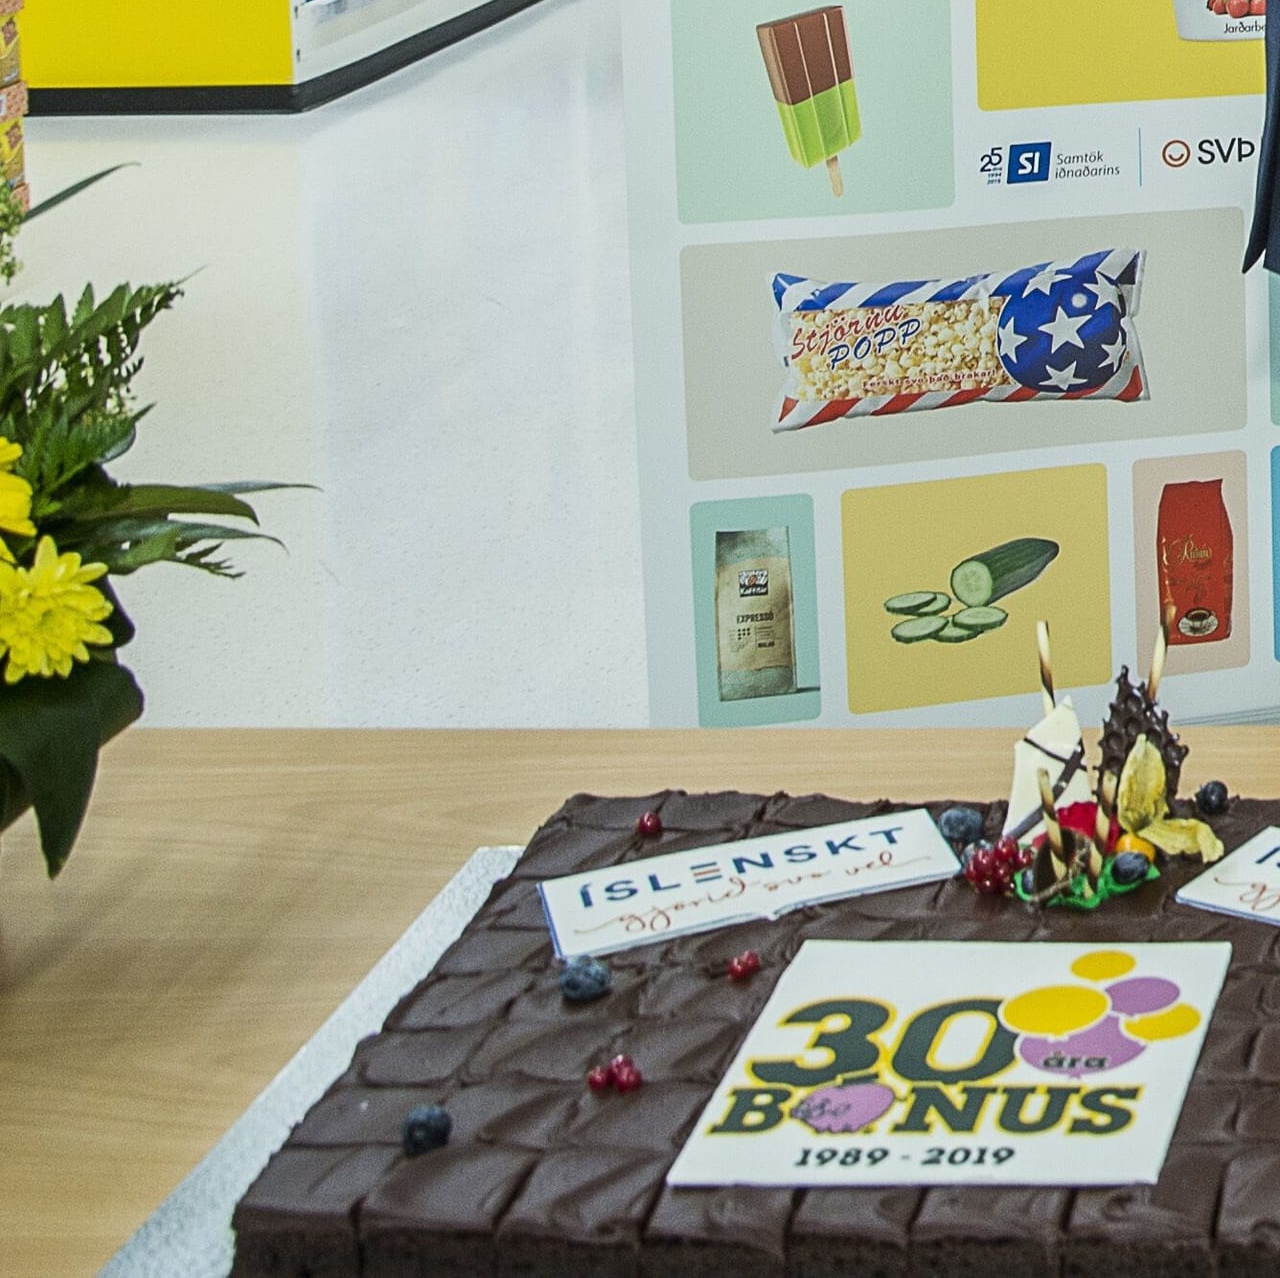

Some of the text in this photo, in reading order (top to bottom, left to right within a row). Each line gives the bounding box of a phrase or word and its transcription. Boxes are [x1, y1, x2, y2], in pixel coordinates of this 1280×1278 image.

[980, 147, 1104, 175] 25 SI Samtök
[1055, 137, 1256, 180] iðnaðarins SVÞ
[791, 303, 910, 360] Stjörnu
[827, 317, 922, 370] POPP
[904, 377, 925, 386] svo
[929, 374, 950, 385] það
[579, 825, 904, 909] ÍSLENSKT
[762, 871, 830, 891] svo
[844, 850, 932, 876] vel
[748, 996, 1020, 1086] 30
[1041, 1048, 1109, 1070] ára
[794, 1147, 890, 1168] 1989
[919, 1146, 1016, 1166] 2019
